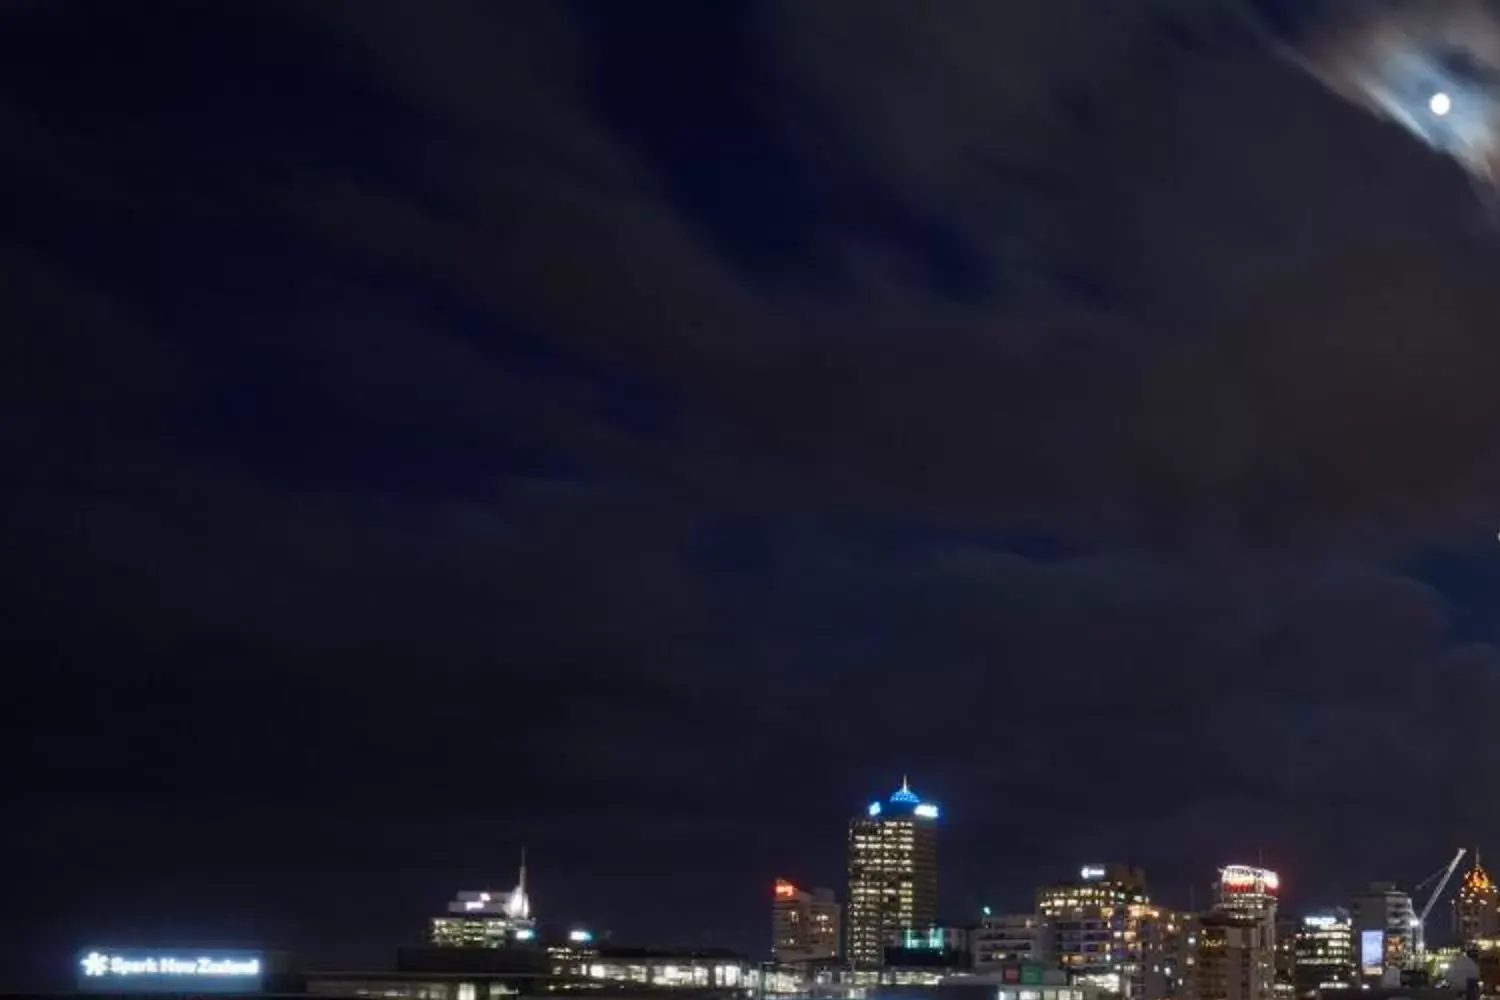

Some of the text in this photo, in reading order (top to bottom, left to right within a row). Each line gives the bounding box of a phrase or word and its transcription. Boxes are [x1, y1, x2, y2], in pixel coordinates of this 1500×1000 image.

[110, 956, 260, 976] Spark New Zealand
